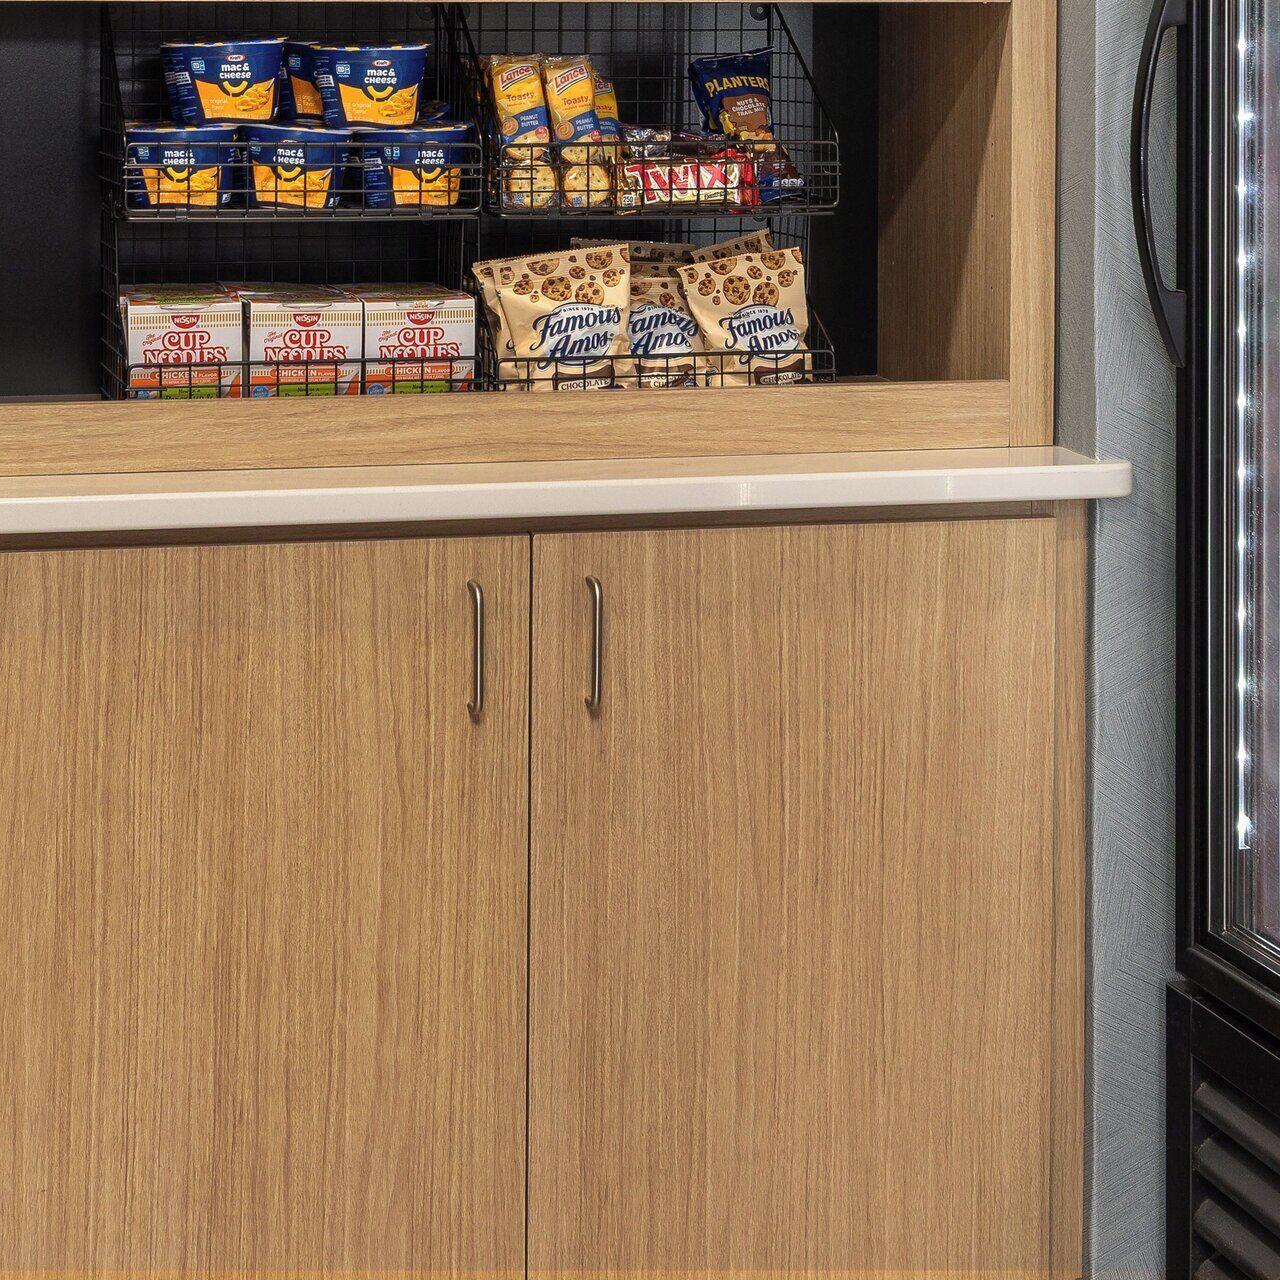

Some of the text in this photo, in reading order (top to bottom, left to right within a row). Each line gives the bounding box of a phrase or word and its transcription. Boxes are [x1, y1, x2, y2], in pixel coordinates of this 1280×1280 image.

[222, 63, 250, 71] mac &
[367, 68, 396, 76] mac &
[501, 66, 531, 84] Lance
[555, 68, 584, 87] Lance
[705, 75, 770, 97] PLANTERS
[506, 92, 535, 102] Toasty
[563, 95, 589, 105] Toasty
[732, 103, 766, 112] CHOCOLATE
[576, 117, 594, 125] PEANUT
[626, 162, 735, 203] TWIX
[174, 316, 197, 324] NISSIN
[296, 314, 318, 322] NISSIN
[530, 307, 620, 351] Famous
[719, 308, 794, 349] Famous
[163, 332, 210, 349] CUP
[285, 330, 331, 347] CUP
[398, 329, 444, 345] CUP
[265, 347, 346, 360] NOODLES
[380, 344, 459, 358] NOODLES
[537, 332, 608, 370] Amos
[739, 330, 797, 364] Amos
[144, 348, 226, 363] NOODLES
[276, 369, 317, 378] CHICKEN
[390, 367, 431, 375] CHICKEN
[561, 378, 609, 390] CHOCOLATE
